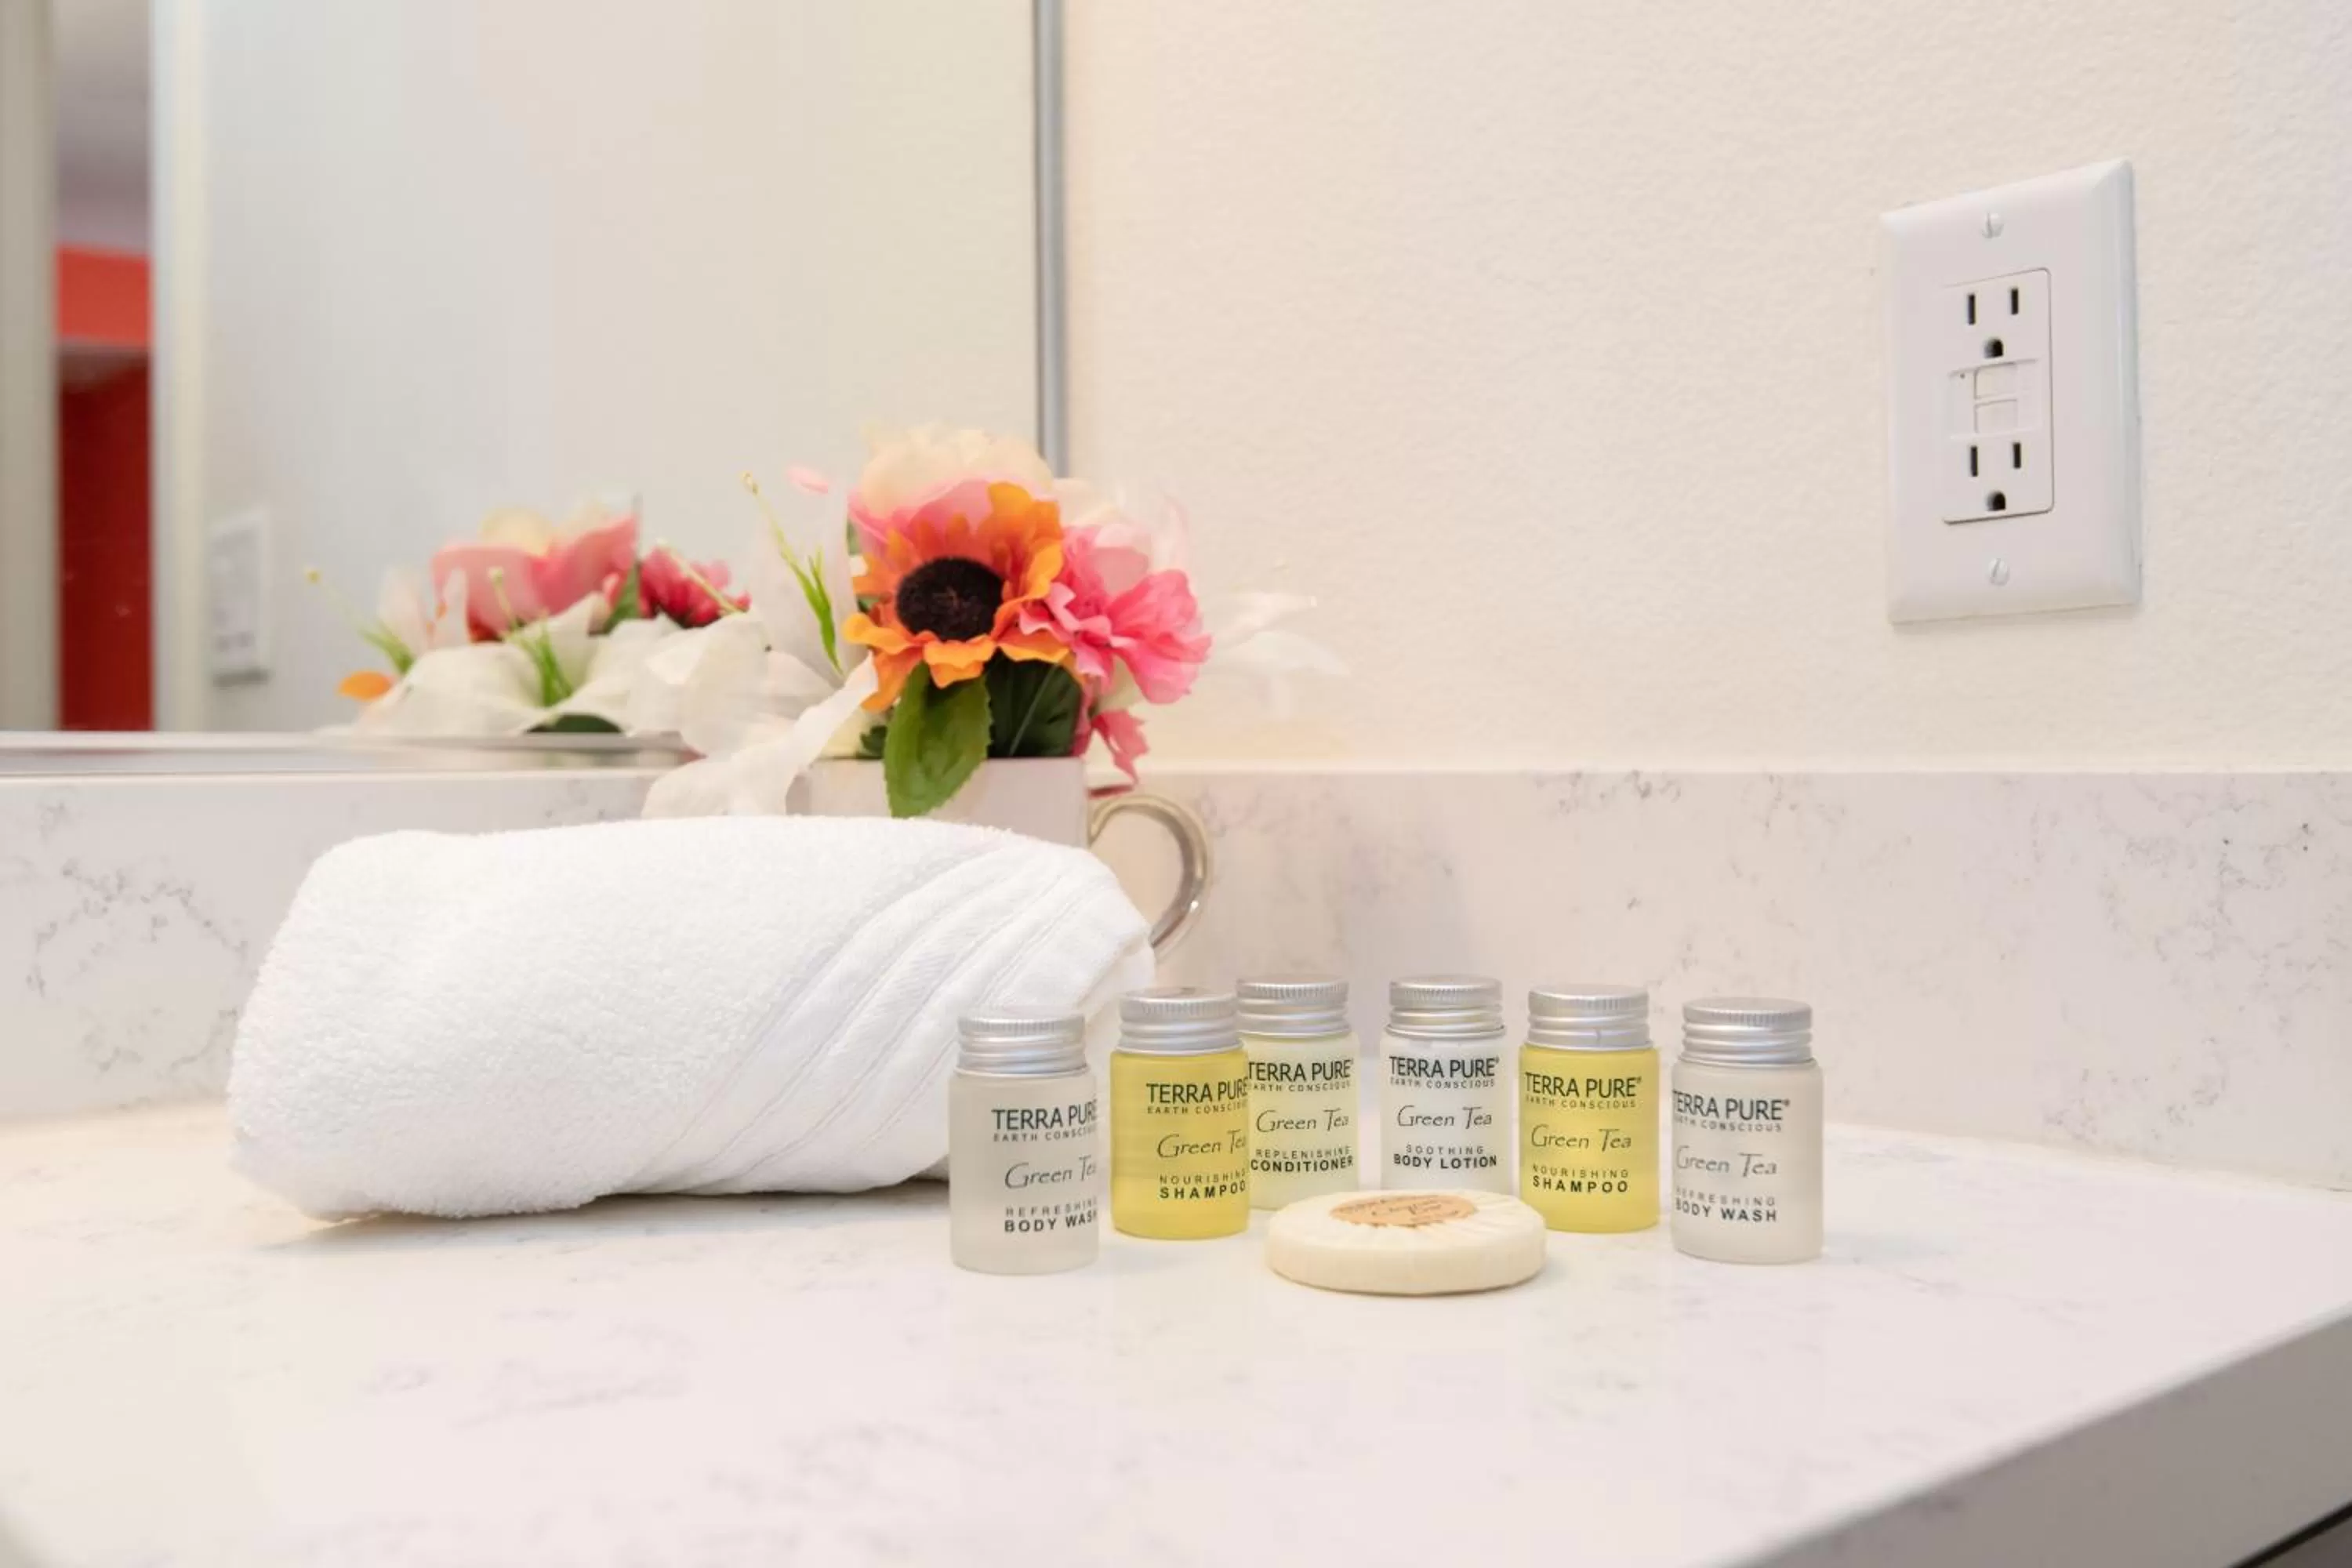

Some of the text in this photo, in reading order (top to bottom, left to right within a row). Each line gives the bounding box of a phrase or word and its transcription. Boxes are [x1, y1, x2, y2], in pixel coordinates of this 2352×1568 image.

[1248, 1062, 1307, 1082] TERRA
[1389, 1056, 1444, 1078] TERRA
[1146, 1083, 1213, 1104] TERRA
[1250, 1083, 1282, 1092] ARTH
[1525, 1072, 1580, 1098] TERRA
[991, 1107, 1063, 1131] TERRA
[1256, 1109, 1317, 1133] Green
[1397, 1105, 1493, 1130] Green Tea
[1157, 1134, 1221, 1158] Green
[1531, 1123, 1632, 1152] Green Tea
[1250, 1156, 1353, 1172] CONDITIONER
[1394, 1153, 1497, 1170] BODY LOTION
[1676, 1145, 1778, 1177] Green Tea
[1004, 1162, 1073, 1189] Green
[1533, 1175, 1628, 1193] SHAMPOO
[1160, 1179, 1245, 1199] SHAMPOO
[1004, 1218, 1056, 1232] BODY
[1720, 1207, 1777, 1222] WASH
